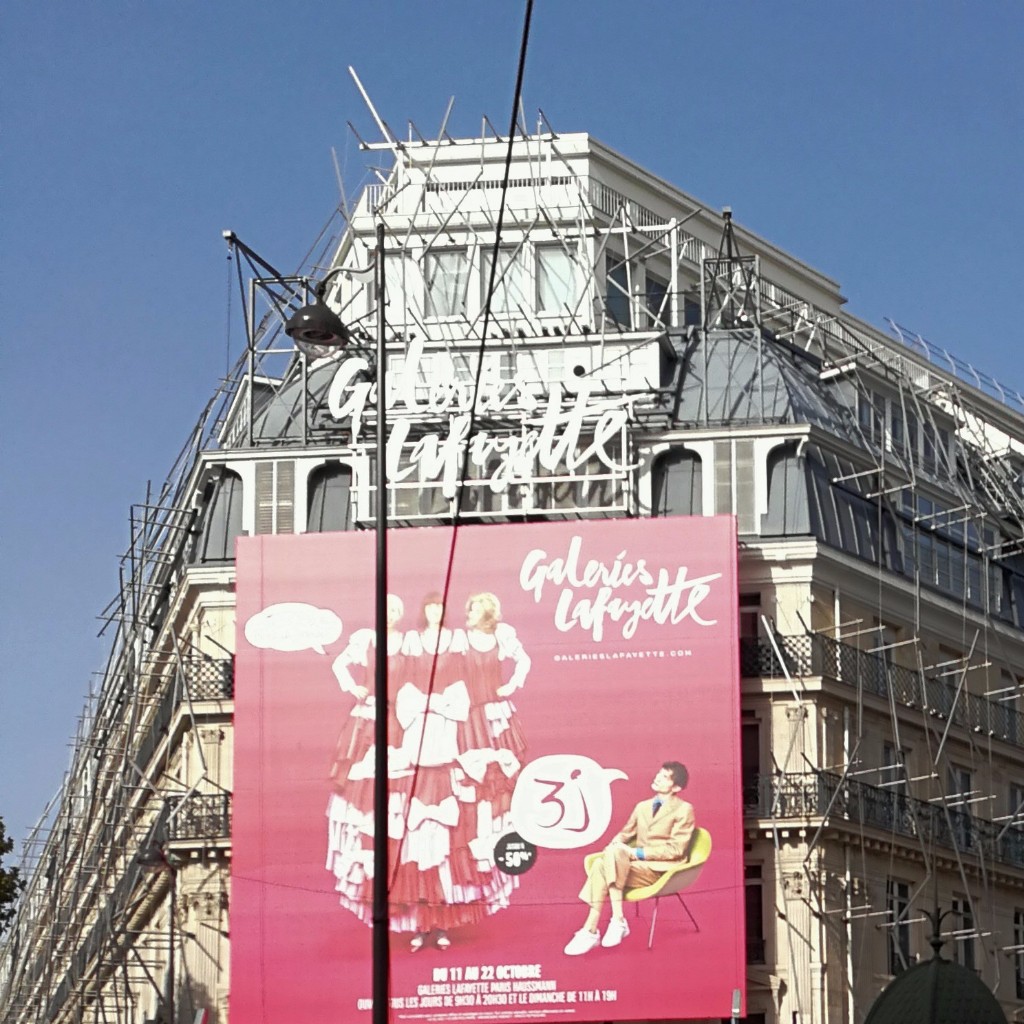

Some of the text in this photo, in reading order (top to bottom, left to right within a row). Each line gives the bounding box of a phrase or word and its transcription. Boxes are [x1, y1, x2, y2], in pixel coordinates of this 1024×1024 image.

[328, 335, 538, 440] Galeries
[385, 382, 656, 499] Lafayette
[519, 535, 654, 603] Galeries
[554, 566, 723, 642] Lafayette
[553, 650, 692, 661] GALERIESLAFAYETTE.COM
[417, 985, 451, 997] GALERIES
[452, 983, 489, 995] LAFAYETTE
[449, 967, 462, 981] 11
[464, 966, 479, 980] AU
[480, 965, 495, 980] 22
[496, 964, 542, 979] OCTOBRE
